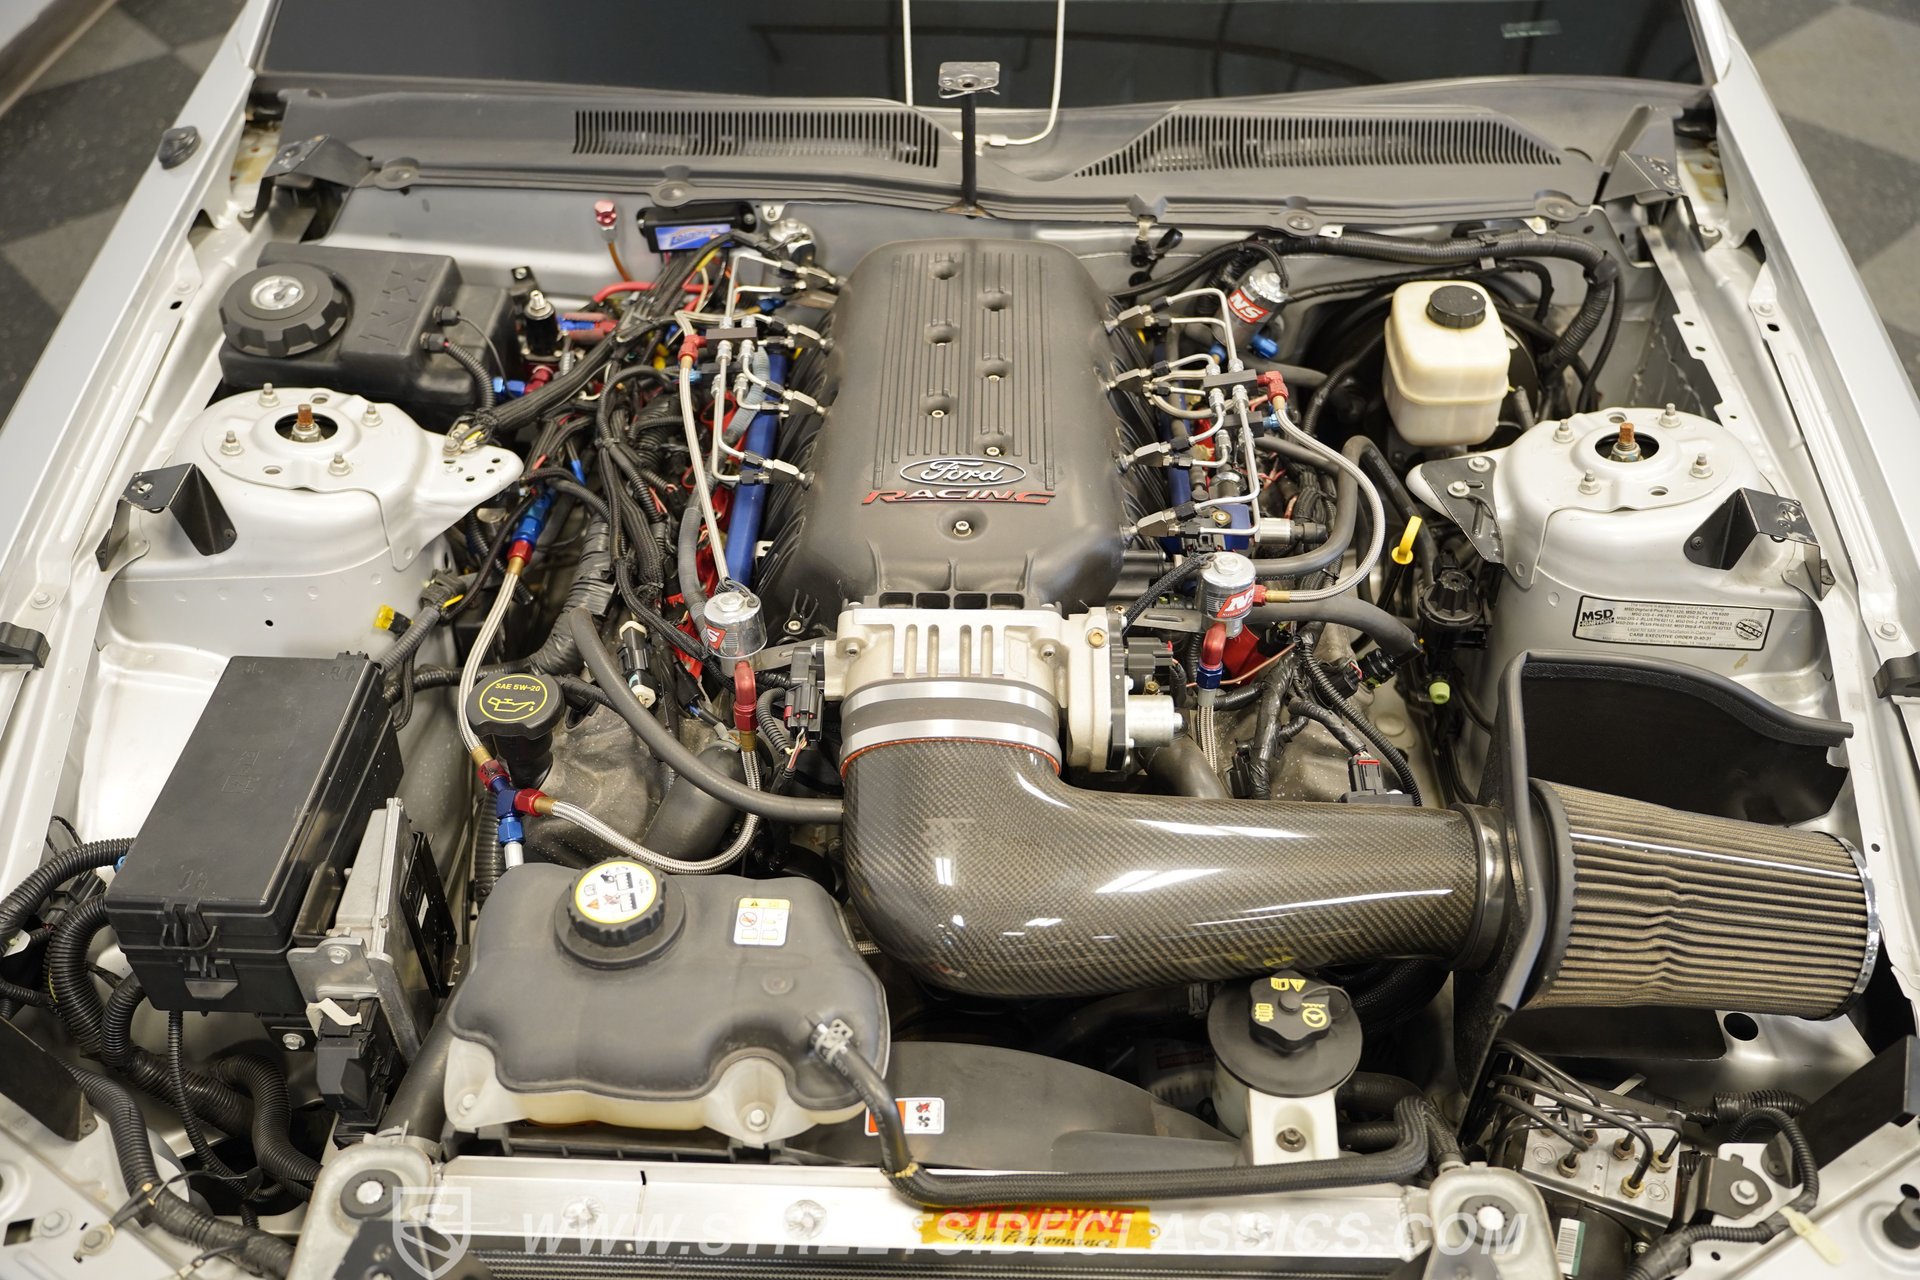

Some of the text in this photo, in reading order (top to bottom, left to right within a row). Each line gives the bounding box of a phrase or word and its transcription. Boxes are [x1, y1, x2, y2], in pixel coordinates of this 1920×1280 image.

[1230, 292, 1264, 319] NS
[921, 460, 1004, 482] Ford
[862, 489, 1055, 505] RACING
[1581, 609, 1614, 623] MSD
[495, 683, 542, 693] SAE 5W-20
